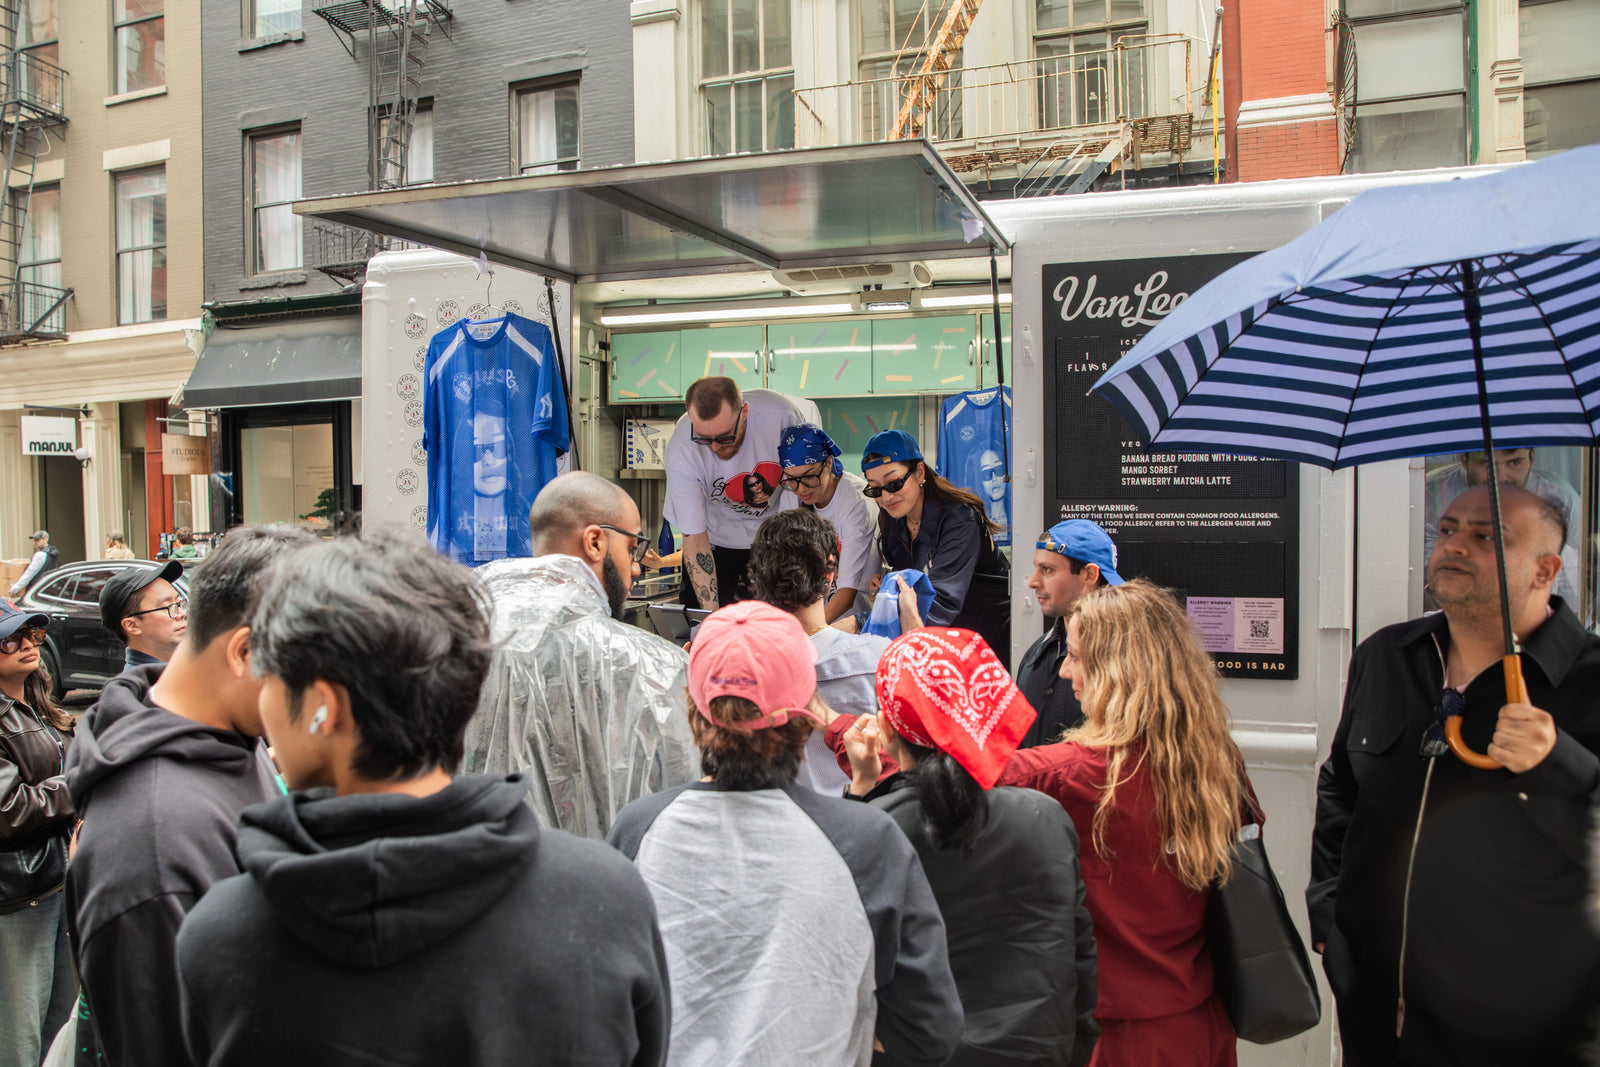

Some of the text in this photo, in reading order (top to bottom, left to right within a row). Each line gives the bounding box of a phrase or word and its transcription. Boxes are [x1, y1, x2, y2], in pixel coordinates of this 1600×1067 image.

[1053, 270, 1189, 328] Van Lee
[1120, 338, 1138, 346] ICE
[29, 441, 74, 452] MANJUL
[1121, 440, 1141, 448] VEG
[170, 448, 206, 456] STUDIOUS
[1121, 454, 1150, 463] BANANA
[1152, 454, 1176, 463] BREAD
[1177, 453, 1209, 462] PUDDING
[1211, 453, 1231, 462] WITH
[1121, 465, 1178, 474] MANGO SORBET
[1121, 476, 1231, 486] STRAWBERRY MATCHA LATTE
[1097, 504, 1139, 512] WARNING:
[1124, 520, 1154, 528] ALLERGY,
[1217, 661, 1285, 670] OOD IS BAD
